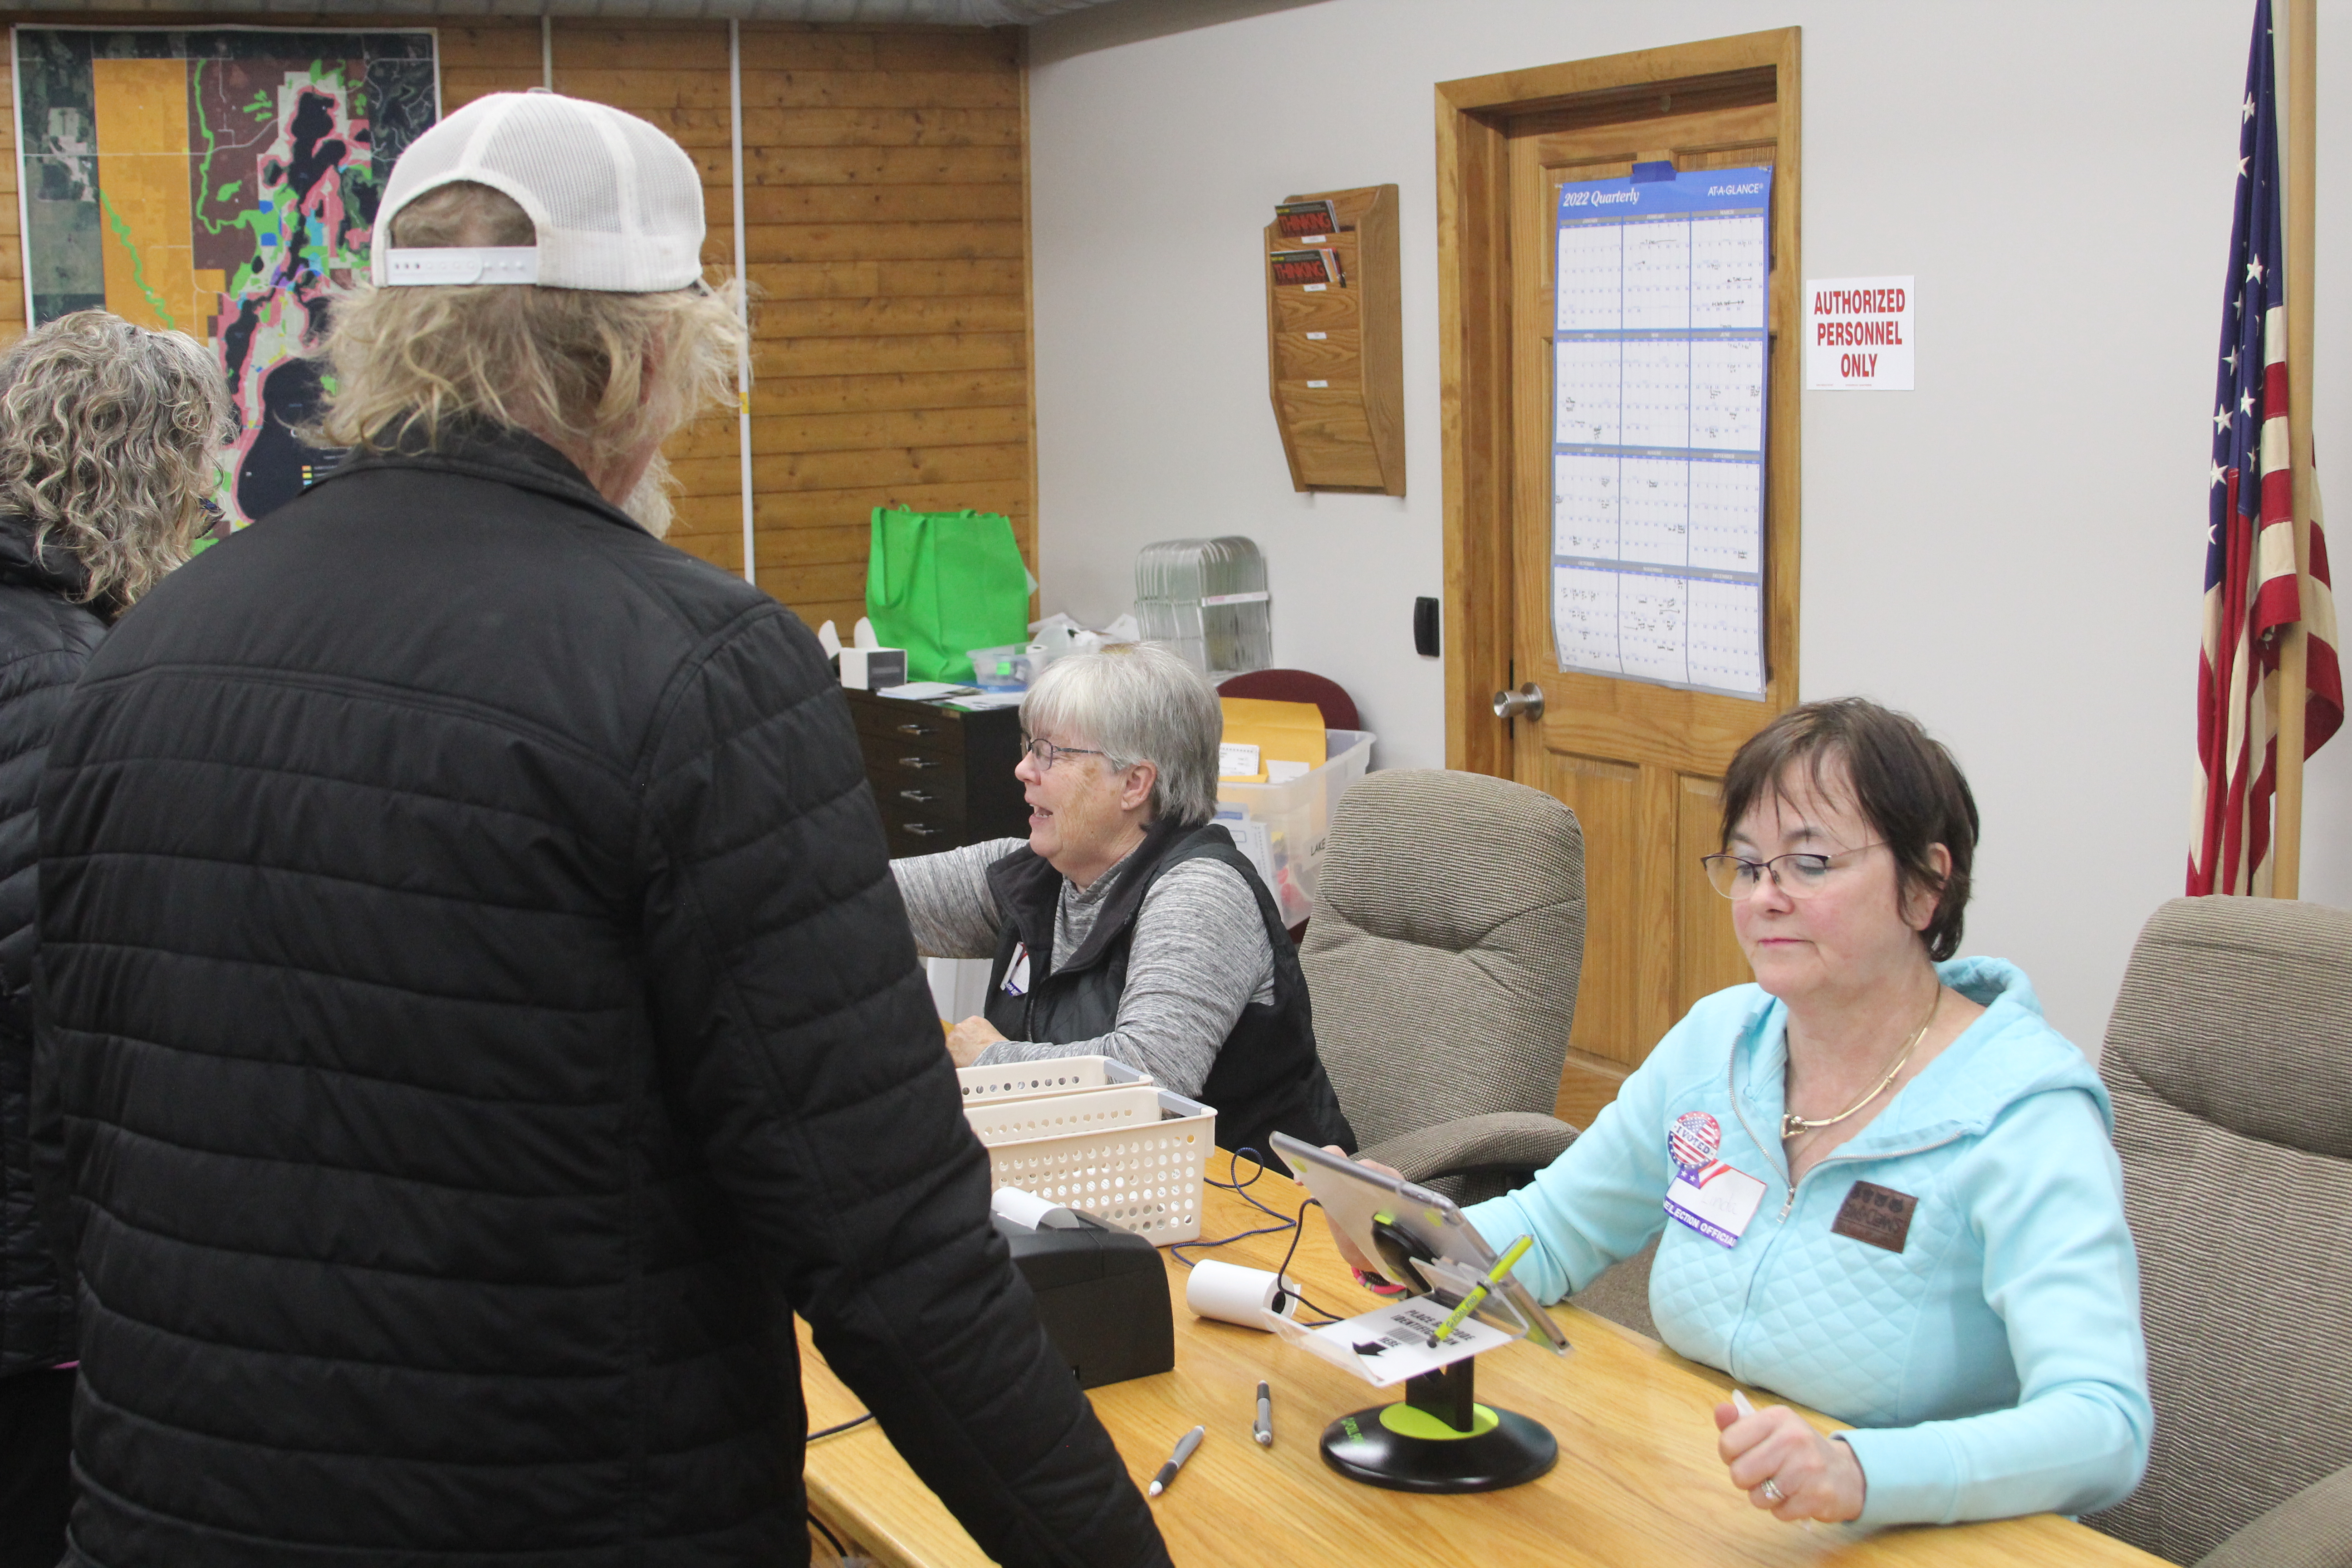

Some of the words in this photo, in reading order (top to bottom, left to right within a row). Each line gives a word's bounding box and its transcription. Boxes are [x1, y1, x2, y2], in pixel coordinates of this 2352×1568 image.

[1563, 191, 1590, 207] 2022
[1590, 186, 1640, 208] Quarterly
[1279, 212, 1332, 232] THINKING
[1274, 261, 1325, 279] THINKING
[1814, 288, 1906, 315] AUTHORIZED
[1817, 321, 1902, 346] PERSONNEL
[1841, 353, 1878, 377] ONLY
[1681, 1129, 1710, 1154] VOTED
[1663, 1200, 1701, 1229] ELECTION
[1405, 1309, 1436, 1323] PLACE
